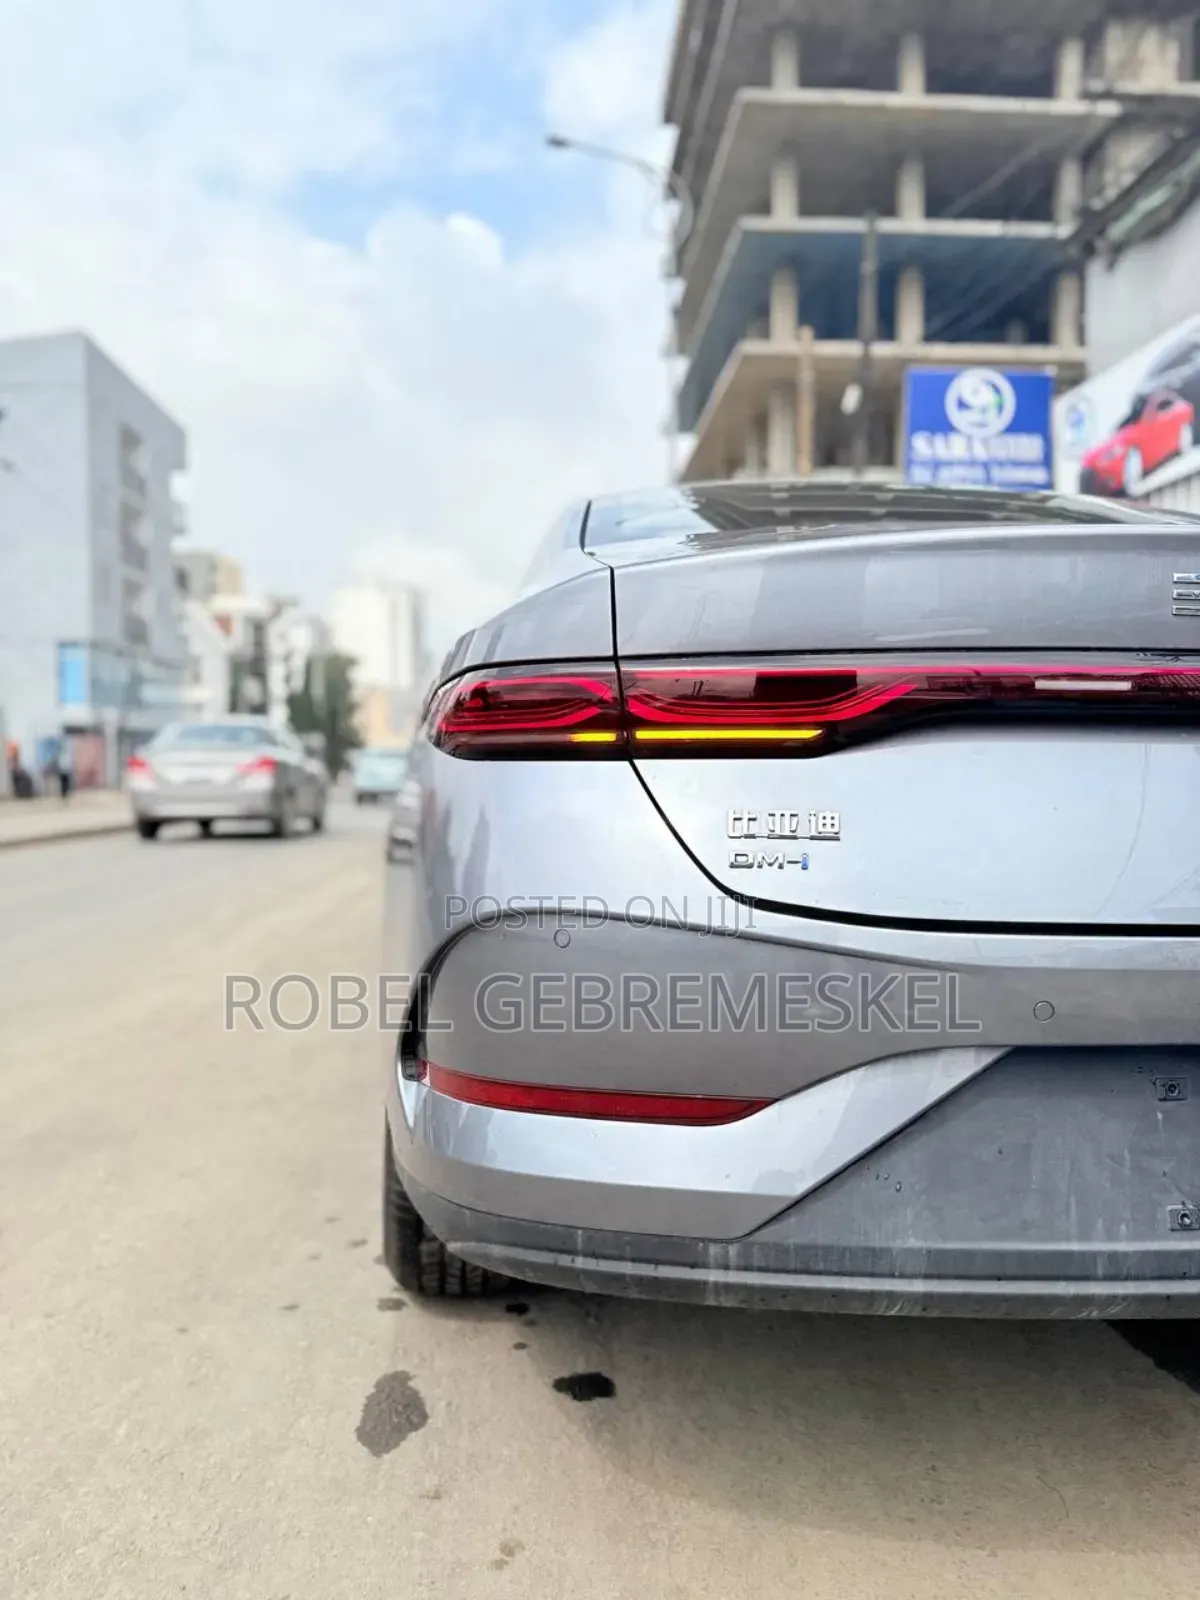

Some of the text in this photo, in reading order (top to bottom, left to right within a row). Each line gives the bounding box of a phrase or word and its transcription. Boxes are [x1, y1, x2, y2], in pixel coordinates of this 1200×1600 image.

[727, 809, 840, 841] 比亚迪
[729, 851, 809, 870] DM-i
